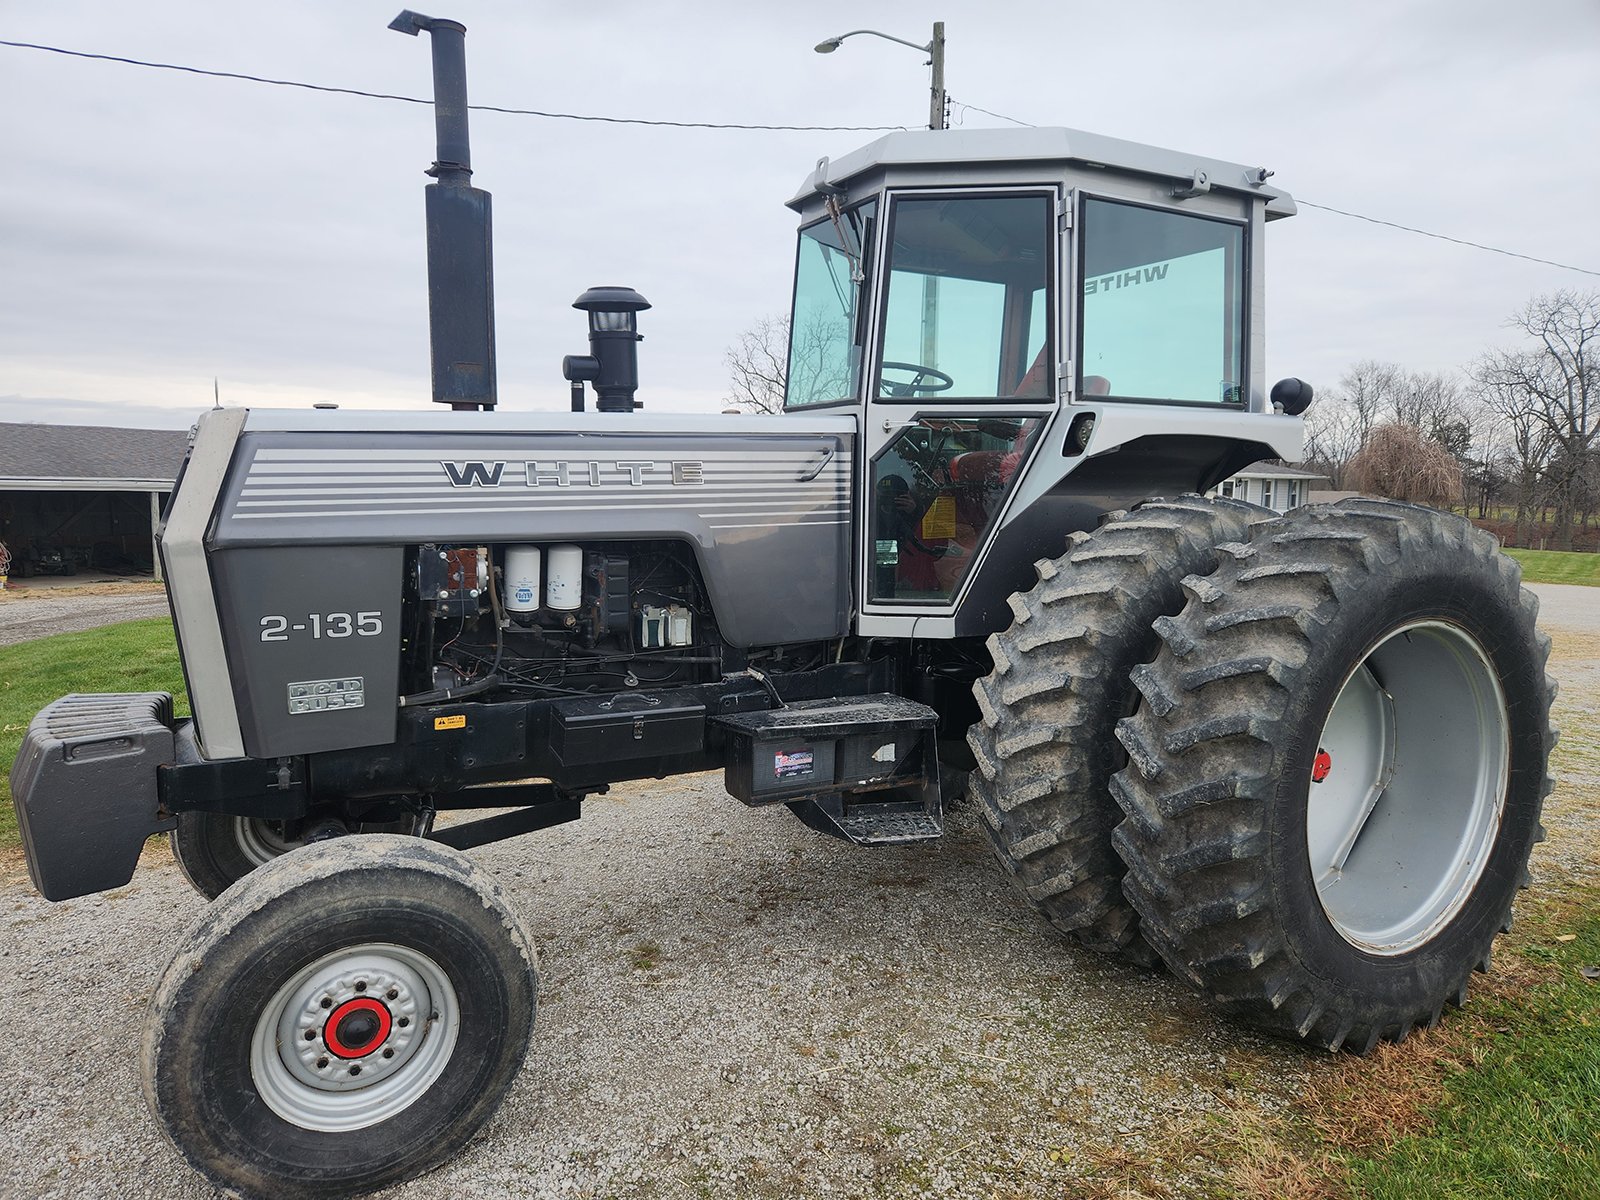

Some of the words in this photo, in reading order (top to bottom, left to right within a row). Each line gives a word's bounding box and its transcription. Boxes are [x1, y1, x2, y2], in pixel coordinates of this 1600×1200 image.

[440, 461, 704, 487] WHITE
[260, 611, 383, 641] 2-135
[290, 693, 364, 712] BOSS
